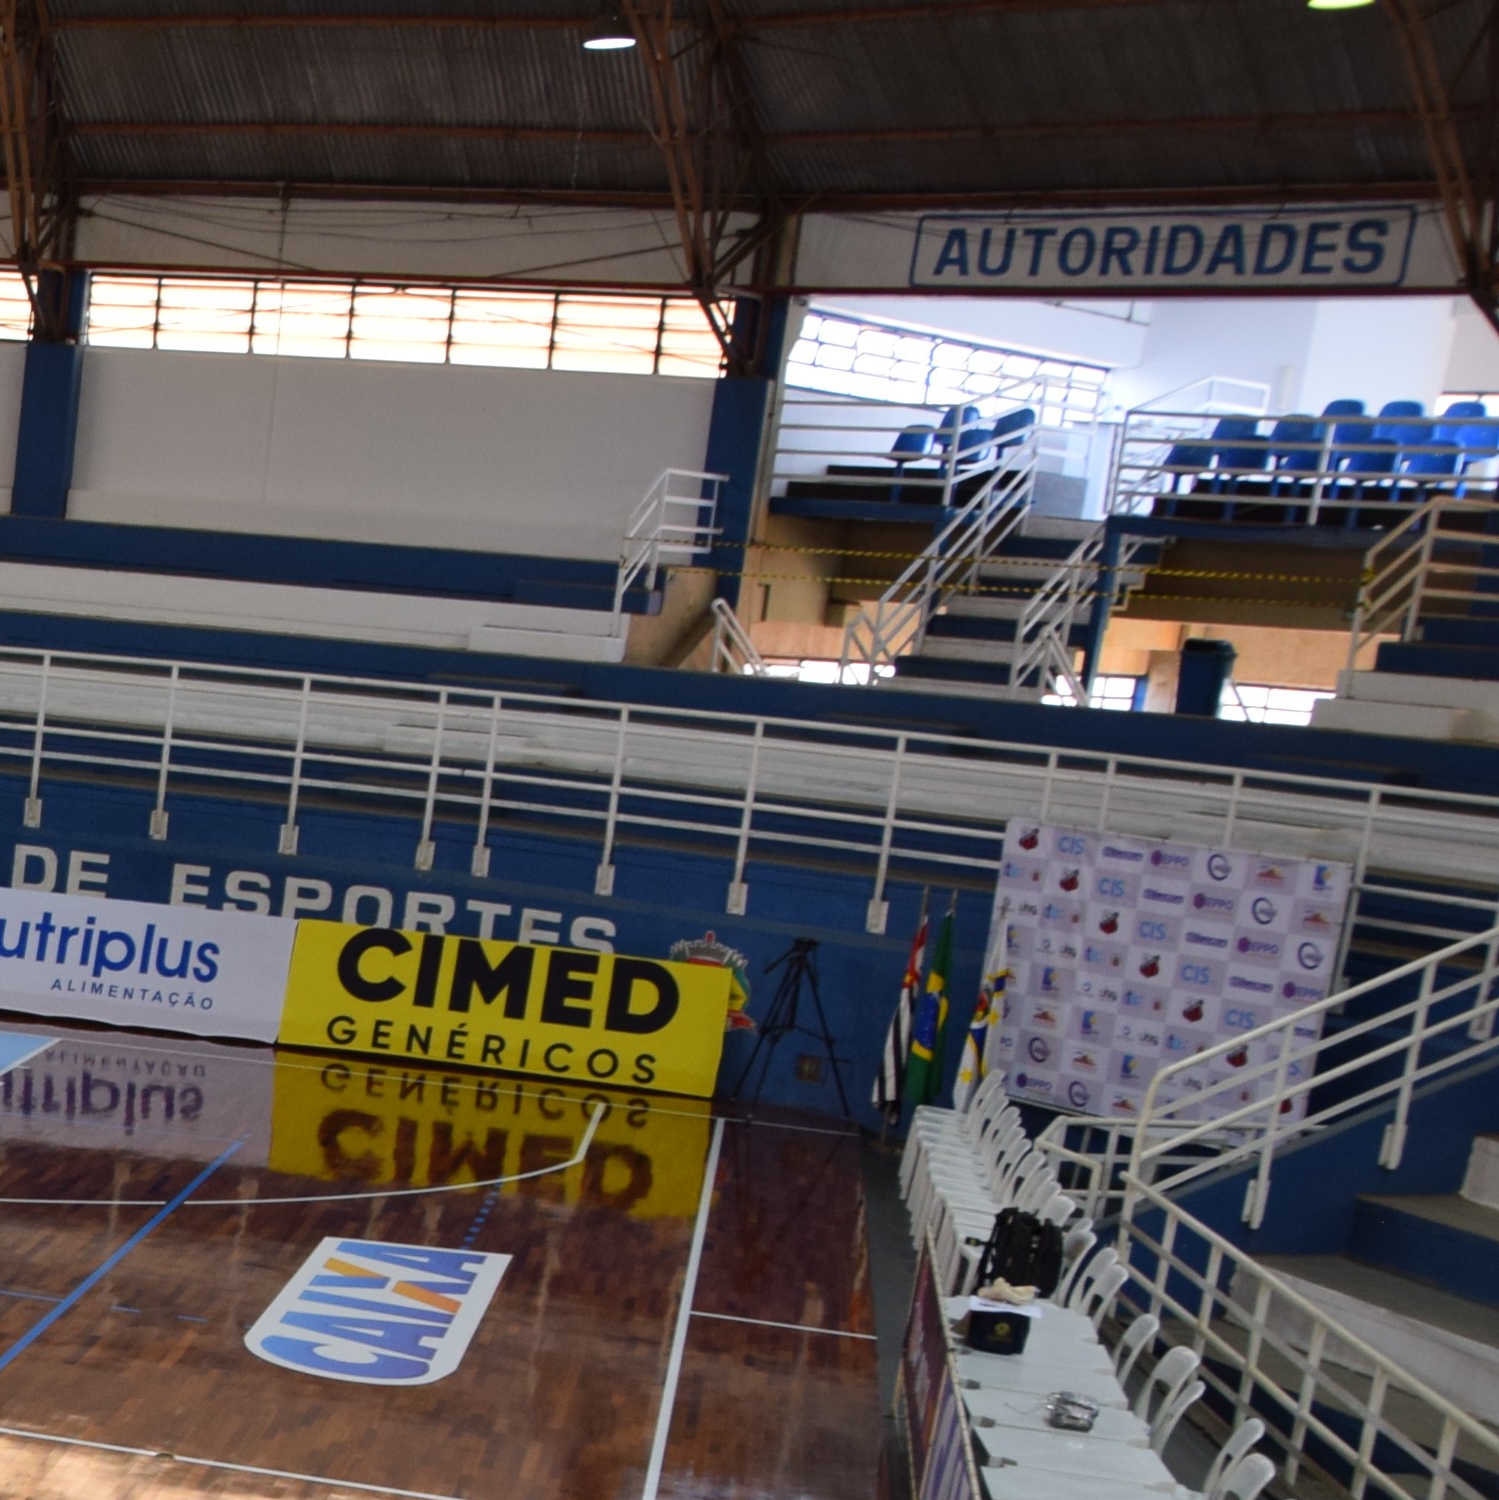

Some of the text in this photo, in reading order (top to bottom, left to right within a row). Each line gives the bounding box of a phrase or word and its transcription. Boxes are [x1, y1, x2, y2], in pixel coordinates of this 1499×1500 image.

[932, 219, 1389, 277] AUTORIDADES
[11, 844, 112, 898] DE
[170, 864, 617, 955] ESPORTES
[50, 978, 214, 1012] ALIMENTAÇÃO
[337, 927, 680, 1036] CIMED
[326, 1014, 658, 1084] GENÉRICOS
[260, 1241, 488, 1379] CAIXA
